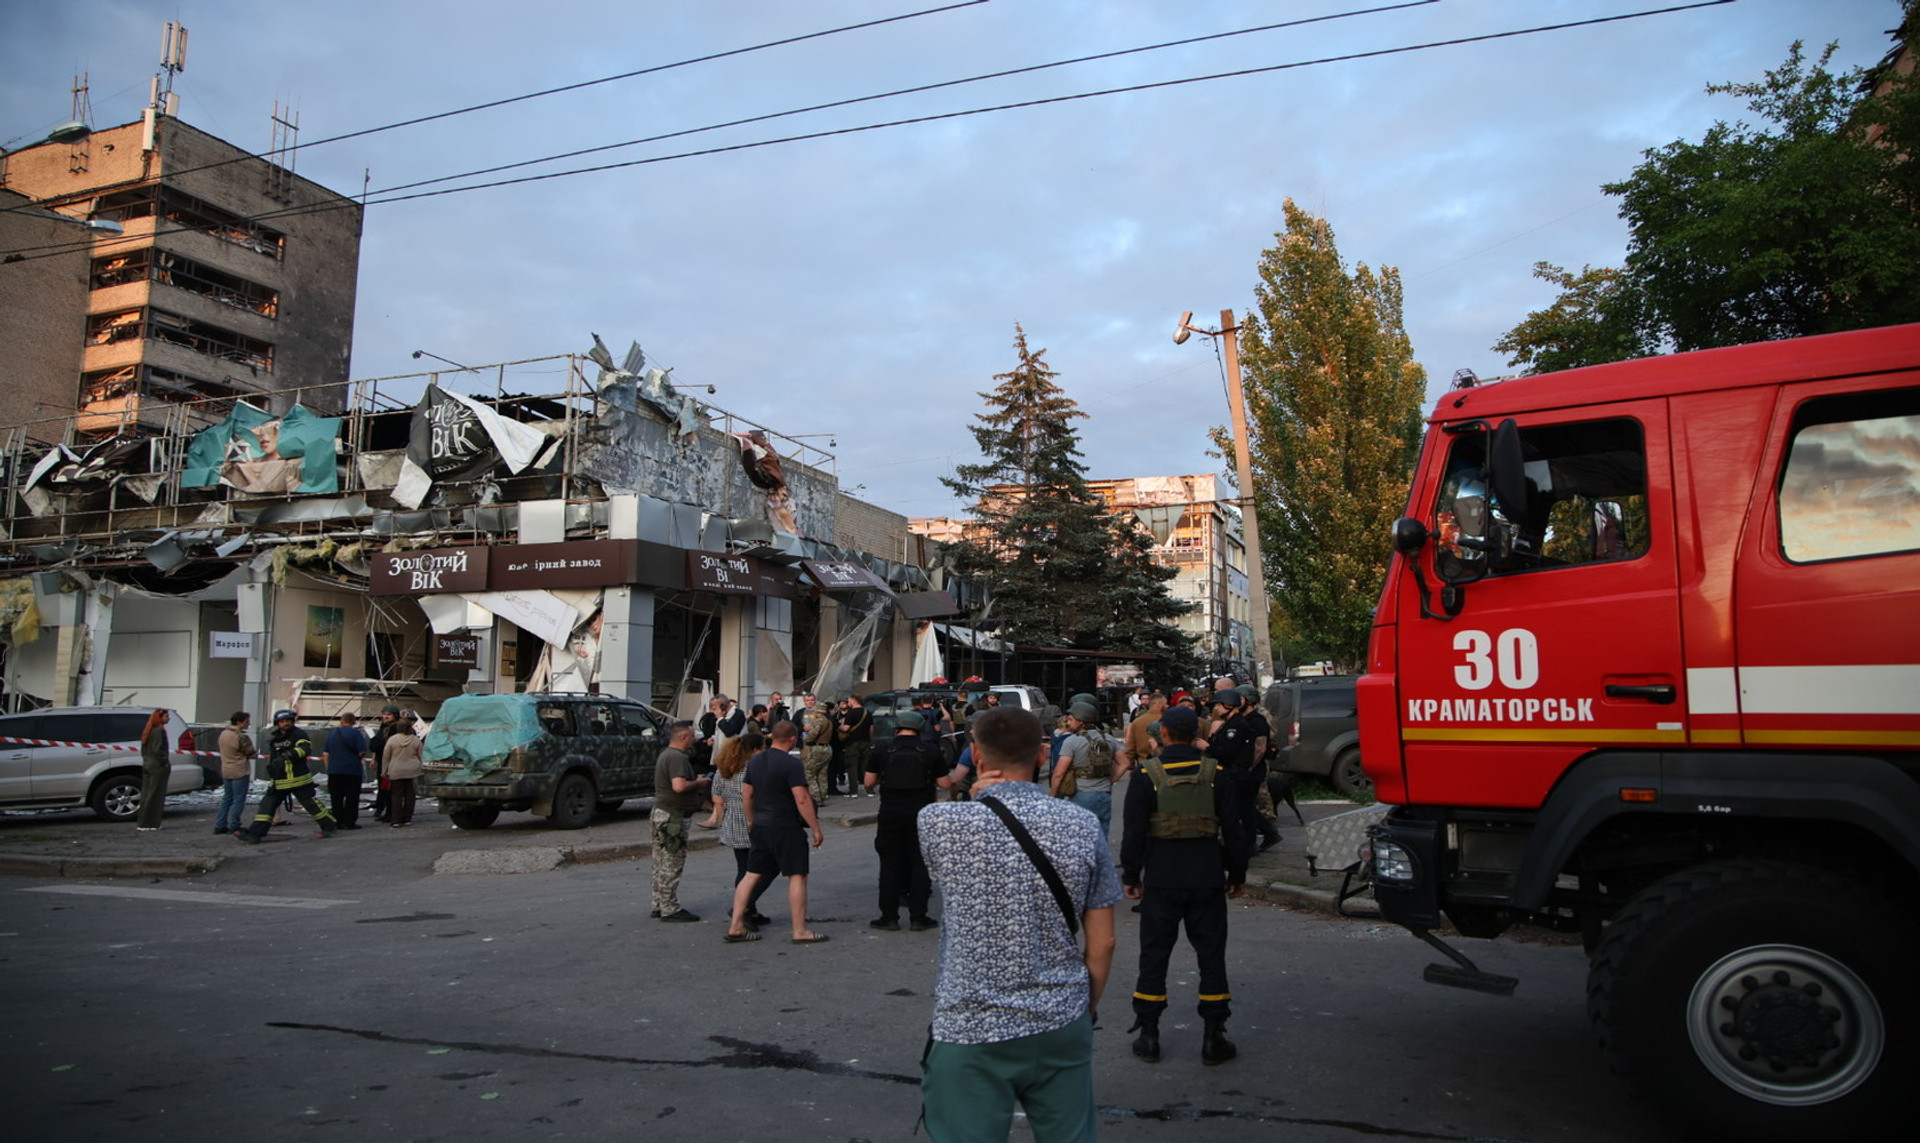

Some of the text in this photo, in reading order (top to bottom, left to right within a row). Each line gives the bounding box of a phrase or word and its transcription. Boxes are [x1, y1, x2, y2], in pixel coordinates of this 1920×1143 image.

[570, 559, 602, 569] завод
[411, 571, 443, 590] ВІК
[1453, 628, 1539, 690] 30
[1408, 698, 1594, 722] КРАМАТОРСЬК
